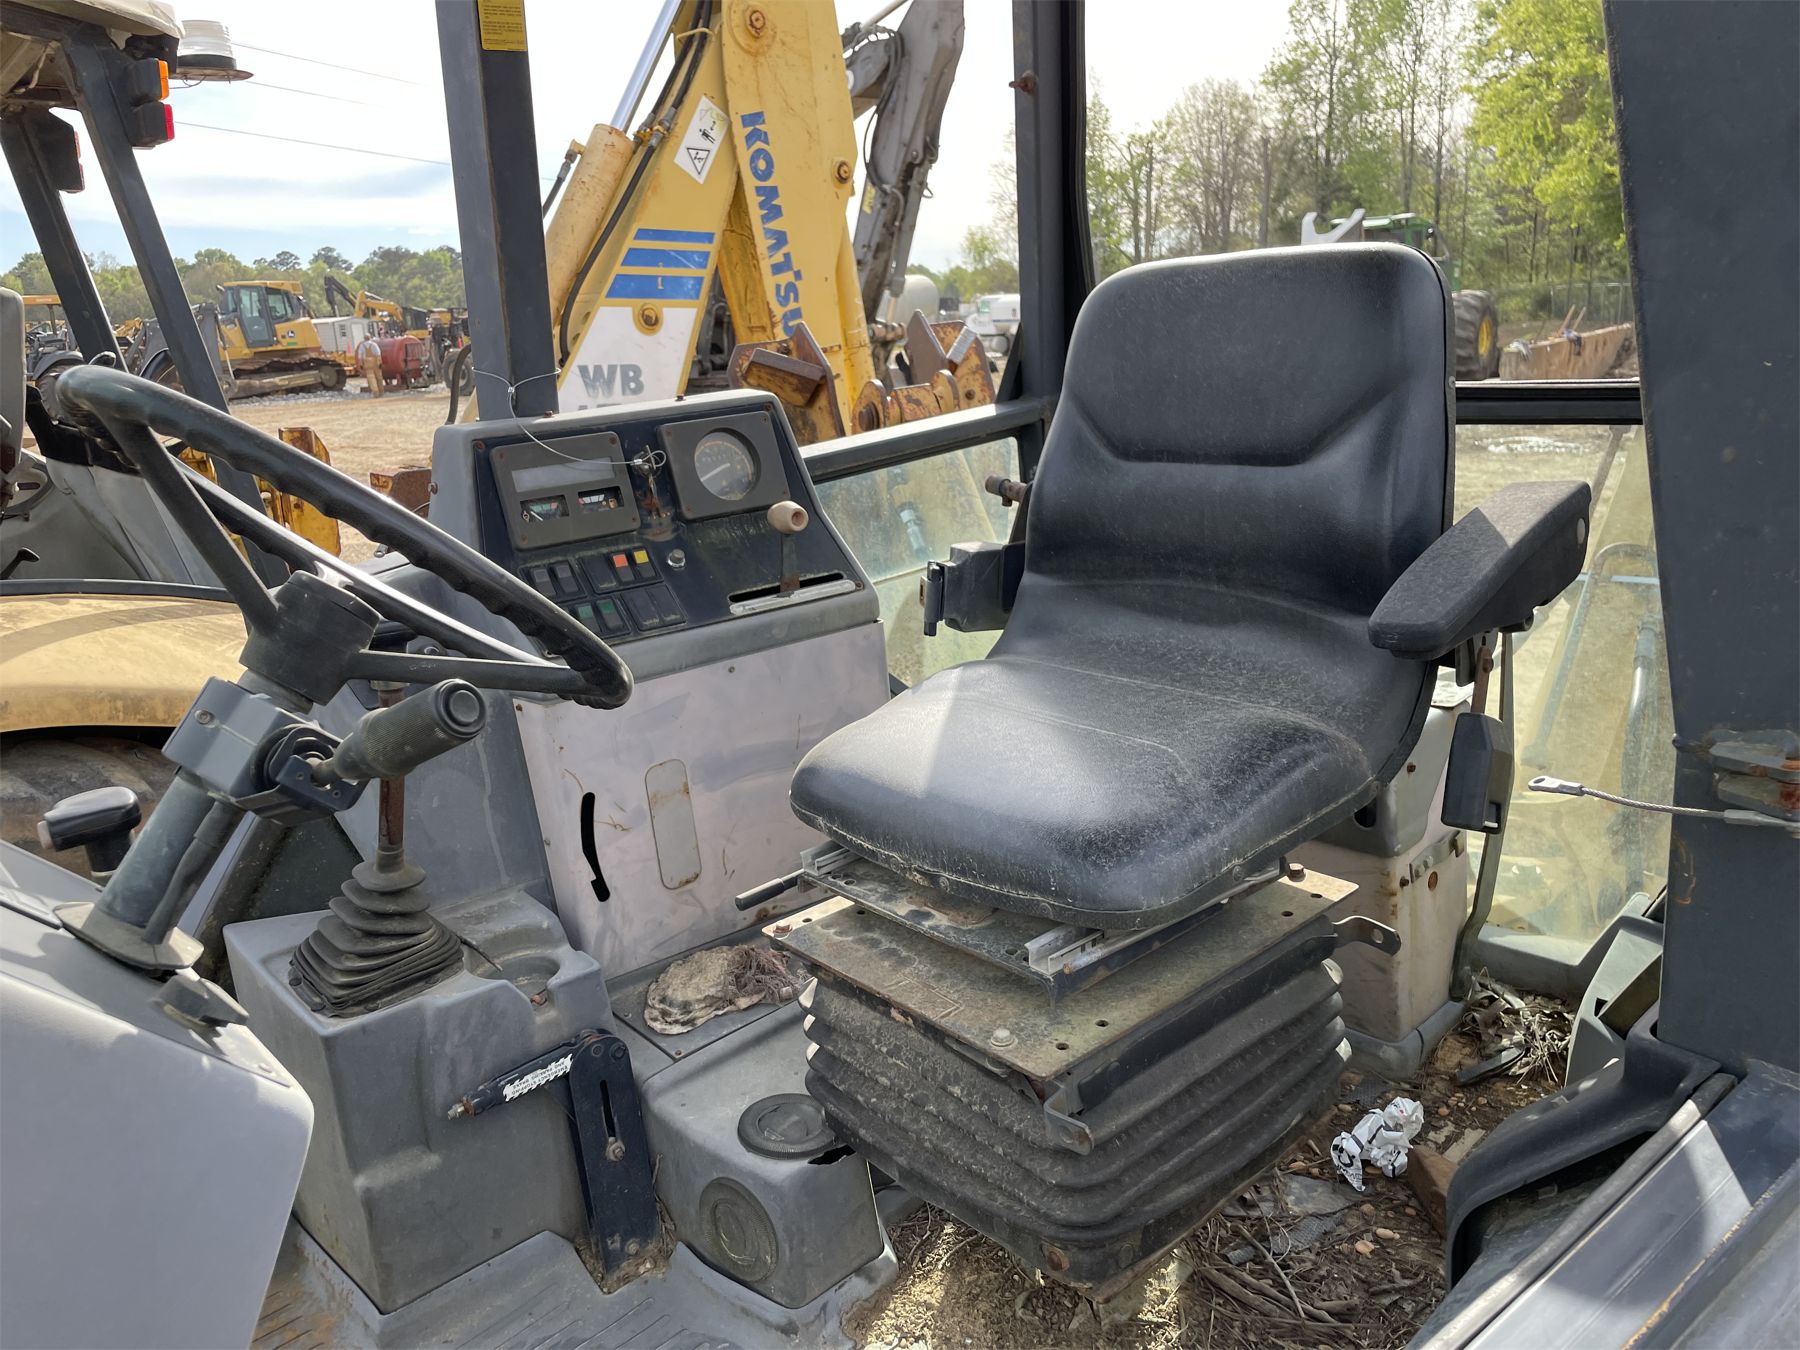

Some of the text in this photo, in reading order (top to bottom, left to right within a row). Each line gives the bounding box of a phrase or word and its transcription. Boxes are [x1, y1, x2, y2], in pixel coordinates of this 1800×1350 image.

[741, 111, 802, 337] KOMATSU
[578, 364, 644, 399] WB
[511, 1065, 568, 1095] EMERGENCY STOPPING
[512, 1061, 565, 1090] AND PARKING BRAKE
